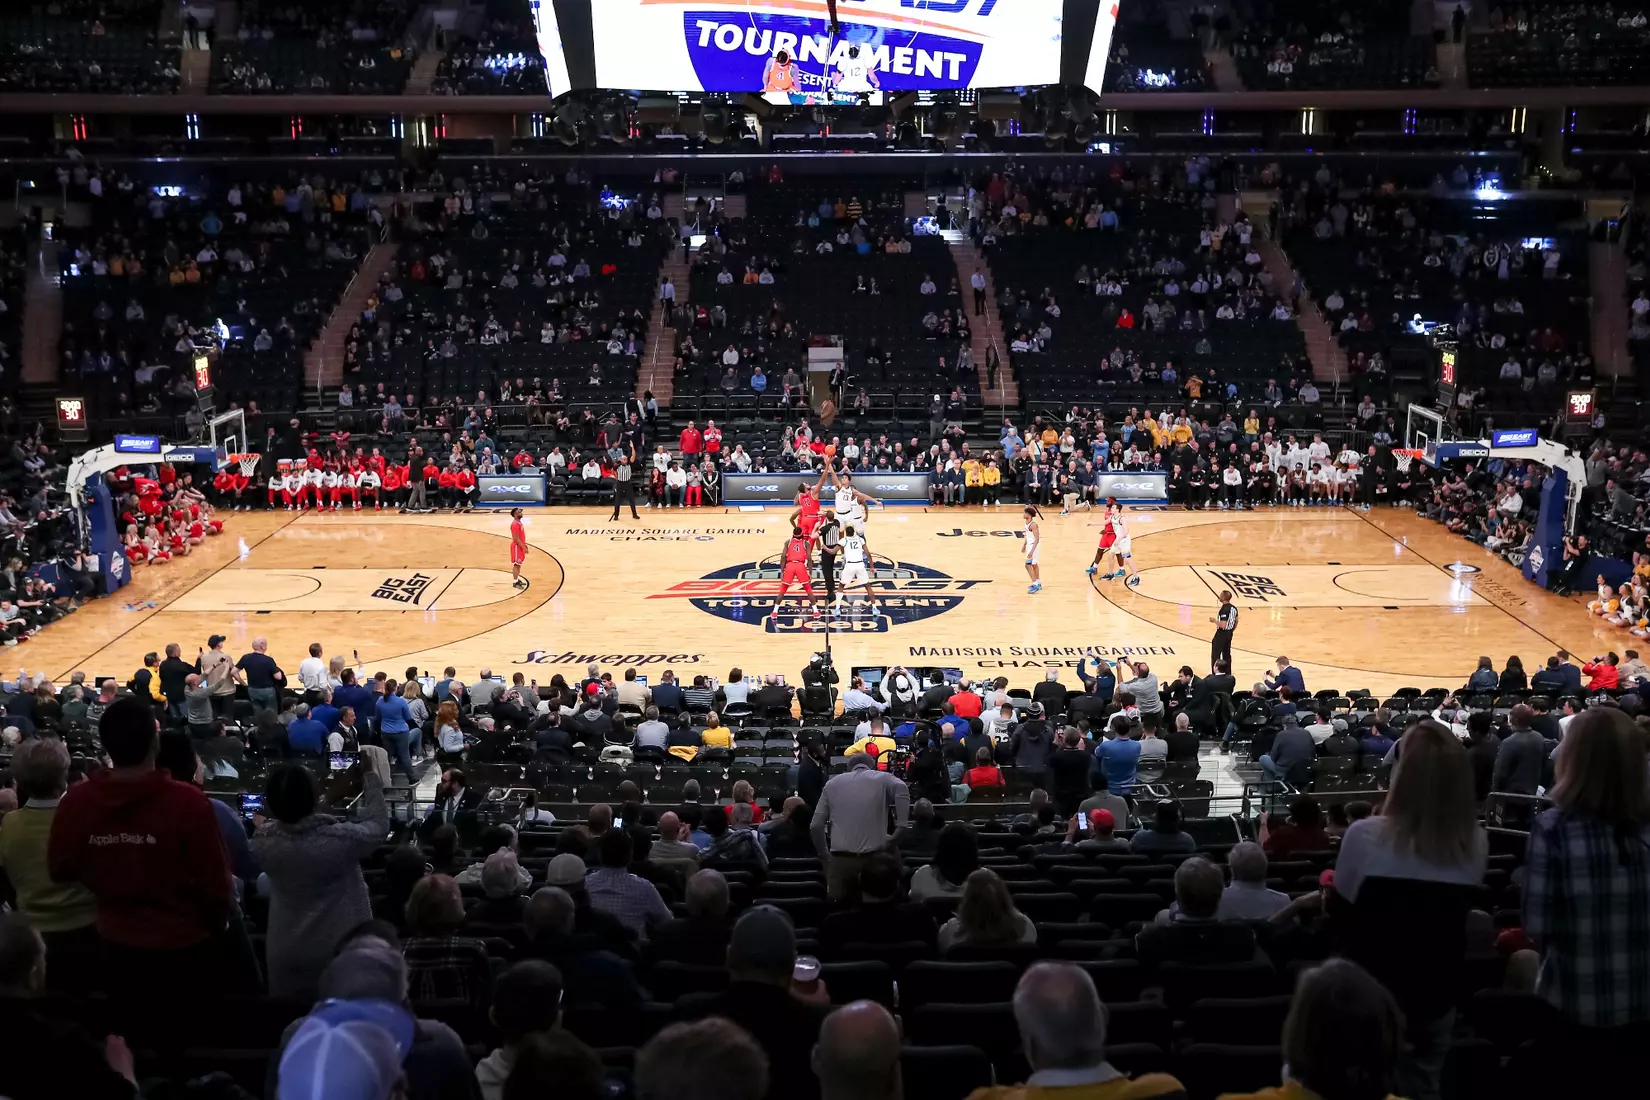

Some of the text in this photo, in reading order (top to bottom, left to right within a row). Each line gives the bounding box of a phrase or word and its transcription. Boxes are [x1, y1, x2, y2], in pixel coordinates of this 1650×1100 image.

[696, 19, 967, 81] TOURNAMENT
[198, 369, 208, 387] 30
[1443, 363, 1453, 382] 30
[1574, 403, 1587, 413] 30
[65, 409, 78, 420] 30
[167, 453, 194, 461] GEICO
[1461, 448, 1487, 456] GEICO
[849, 541, 859, 550] 12
[776, 618, 879, 632] Jeep
[909, 646, 1003, 656] MADISON
[1094, 645, 1176, 656] GARDEN
[511, 650, 705, 667] Schweppes
[977, 660, 1081, 668] CHASE
[89, 834, 119, 846] Apple
